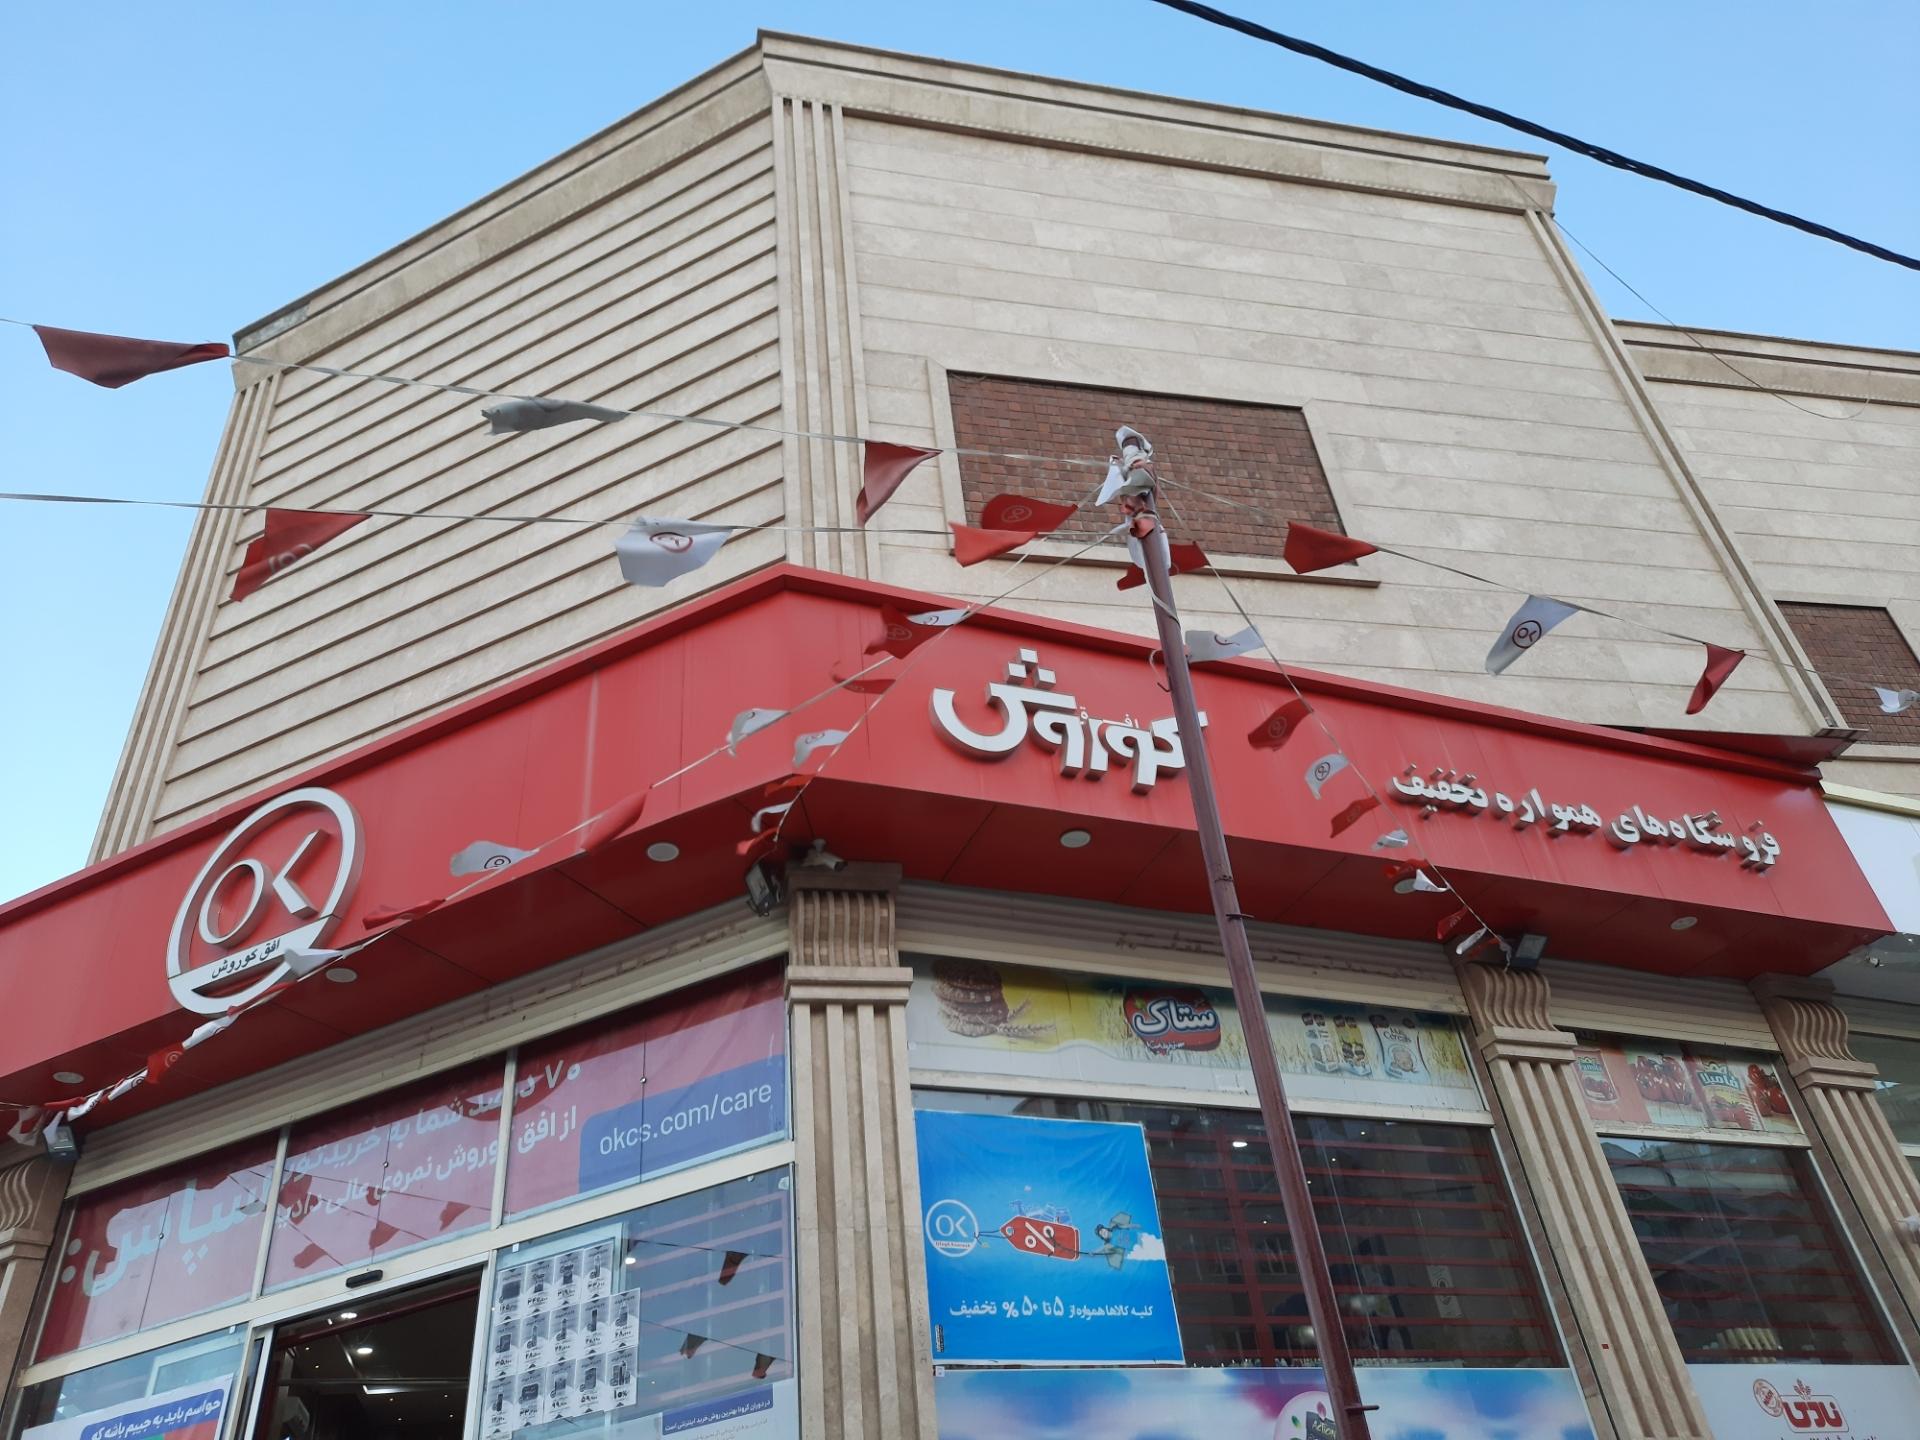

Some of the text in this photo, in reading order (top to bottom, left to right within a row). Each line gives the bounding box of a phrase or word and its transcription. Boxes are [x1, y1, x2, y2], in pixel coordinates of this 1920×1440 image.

[932, 648, 1208, 790] کوروش
[1386, 763, 1490, 820] تخفیف
[1493, 787, 1603, 837] همواره
[198, 828, 331, 944] OK
[211, 937, 281, 979] افق کوروش
[416, 1096, 464, 1136] شما
[559, 1105, 577, 1141] از
[599, 1084, 772, 1155] okcs.com/care
[386, 1124, 411, 1144] به
[517, 1111, 556, 1154] افق
[436, 1138, 501, 1181] وروش
[935, 1214, 968, 1238] OK
[950, 1300, 998, 1318] تخفیف
[1042, 1302, 1053, 1316] تا
[1053, 1296, 1065, 1317] ۵
[1131, 1305, 1154, 1318] کلیه
[152, 1414, 164, 1429] به
[165, 1406, 185, 1425] باید
[184, 1399, 221, 1422] حواسم
[104, 1422, 126, 1439] باشه
[126, 1419, 151, 1436] جیبم
